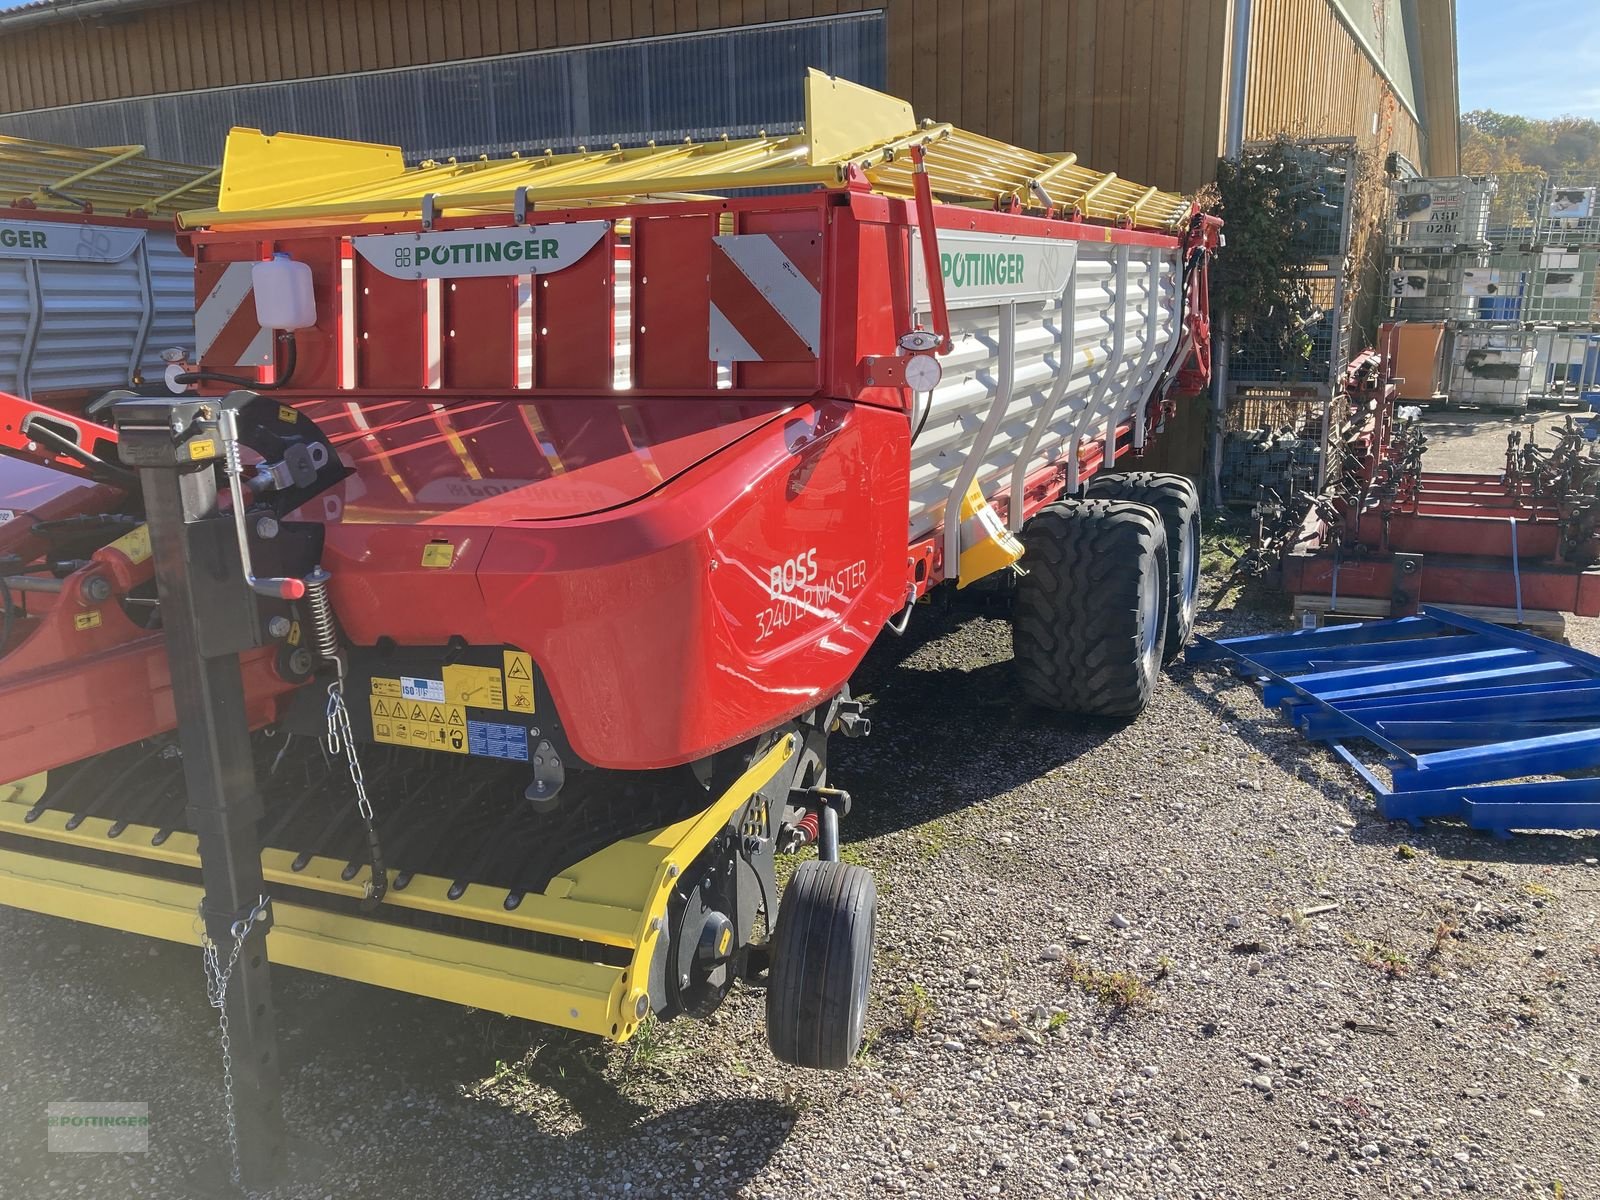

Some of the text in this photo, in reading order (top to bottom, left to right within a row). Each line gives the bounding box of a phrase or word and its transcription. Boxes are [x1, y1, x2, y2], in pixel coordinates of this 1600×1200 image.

[756, 600, 792, 643] 3240
[816, 559, 866, 608] MASTER
[770, 547, 817, 600] BOSS
